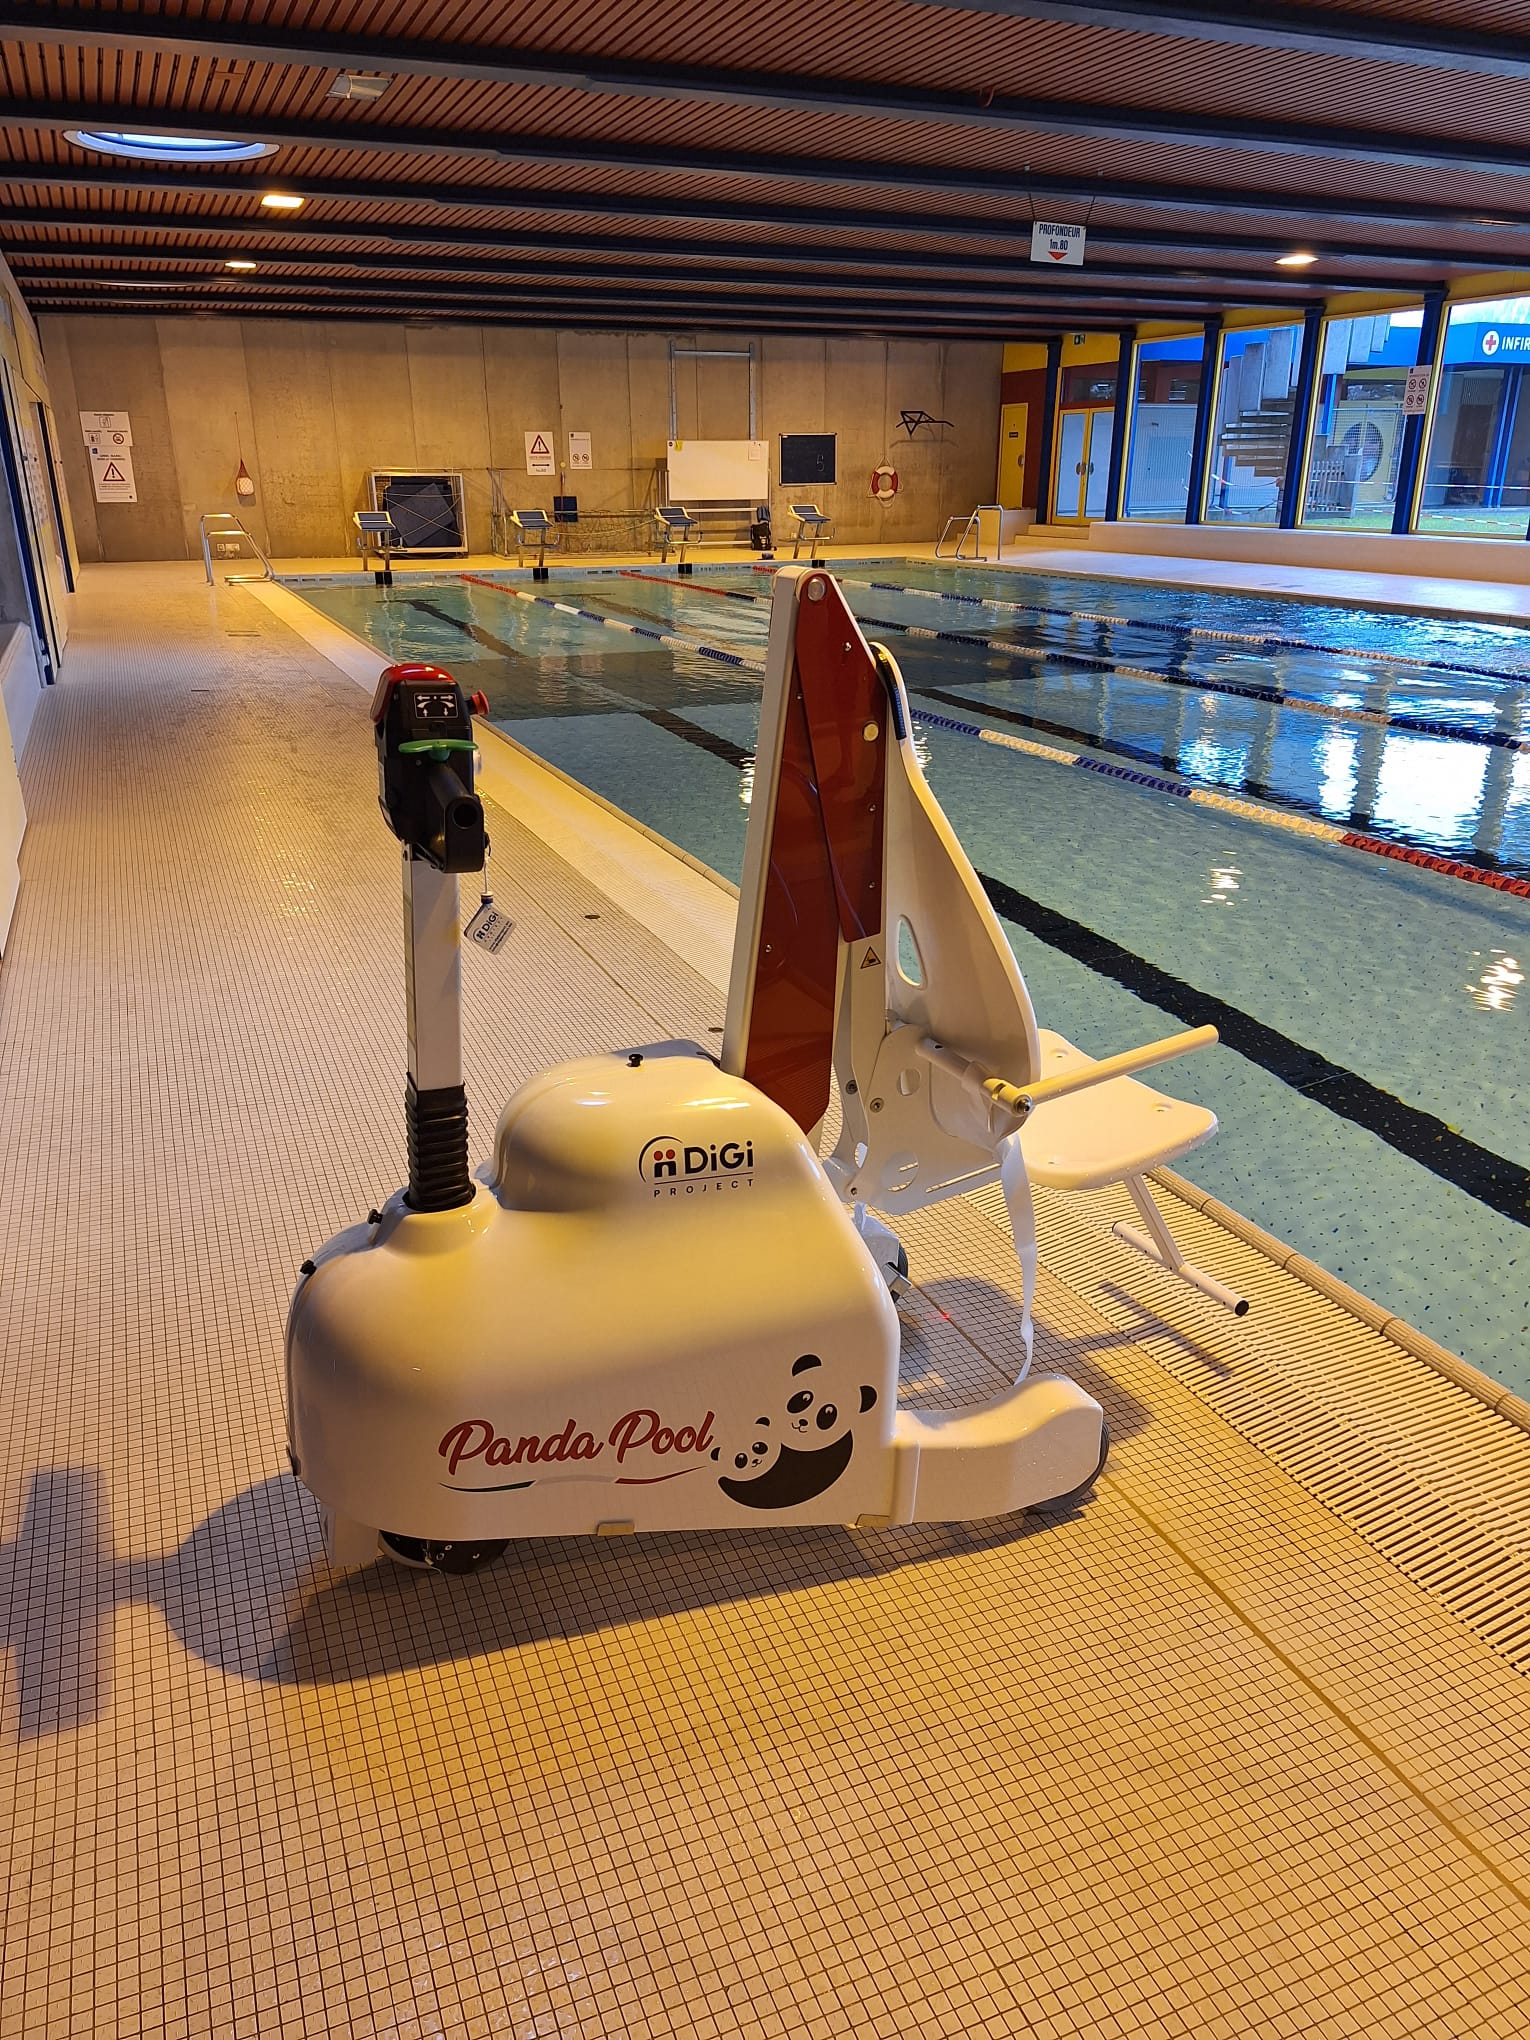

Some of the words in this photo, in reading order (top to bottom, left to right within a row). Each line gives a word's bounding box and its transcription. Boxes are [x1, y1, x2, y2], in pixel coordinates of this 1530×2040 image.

[1039, 224, 1080, 238] PROFONDEUR
[1501, 336, 1530, 350] INFIR
[683, 1140, 754, 1175] DiGi
[653, 1178, 754, 1198] PROJECT
[438, 1419, 604, 1476] Panda
[608, 1409, 715, 1464] Pool
